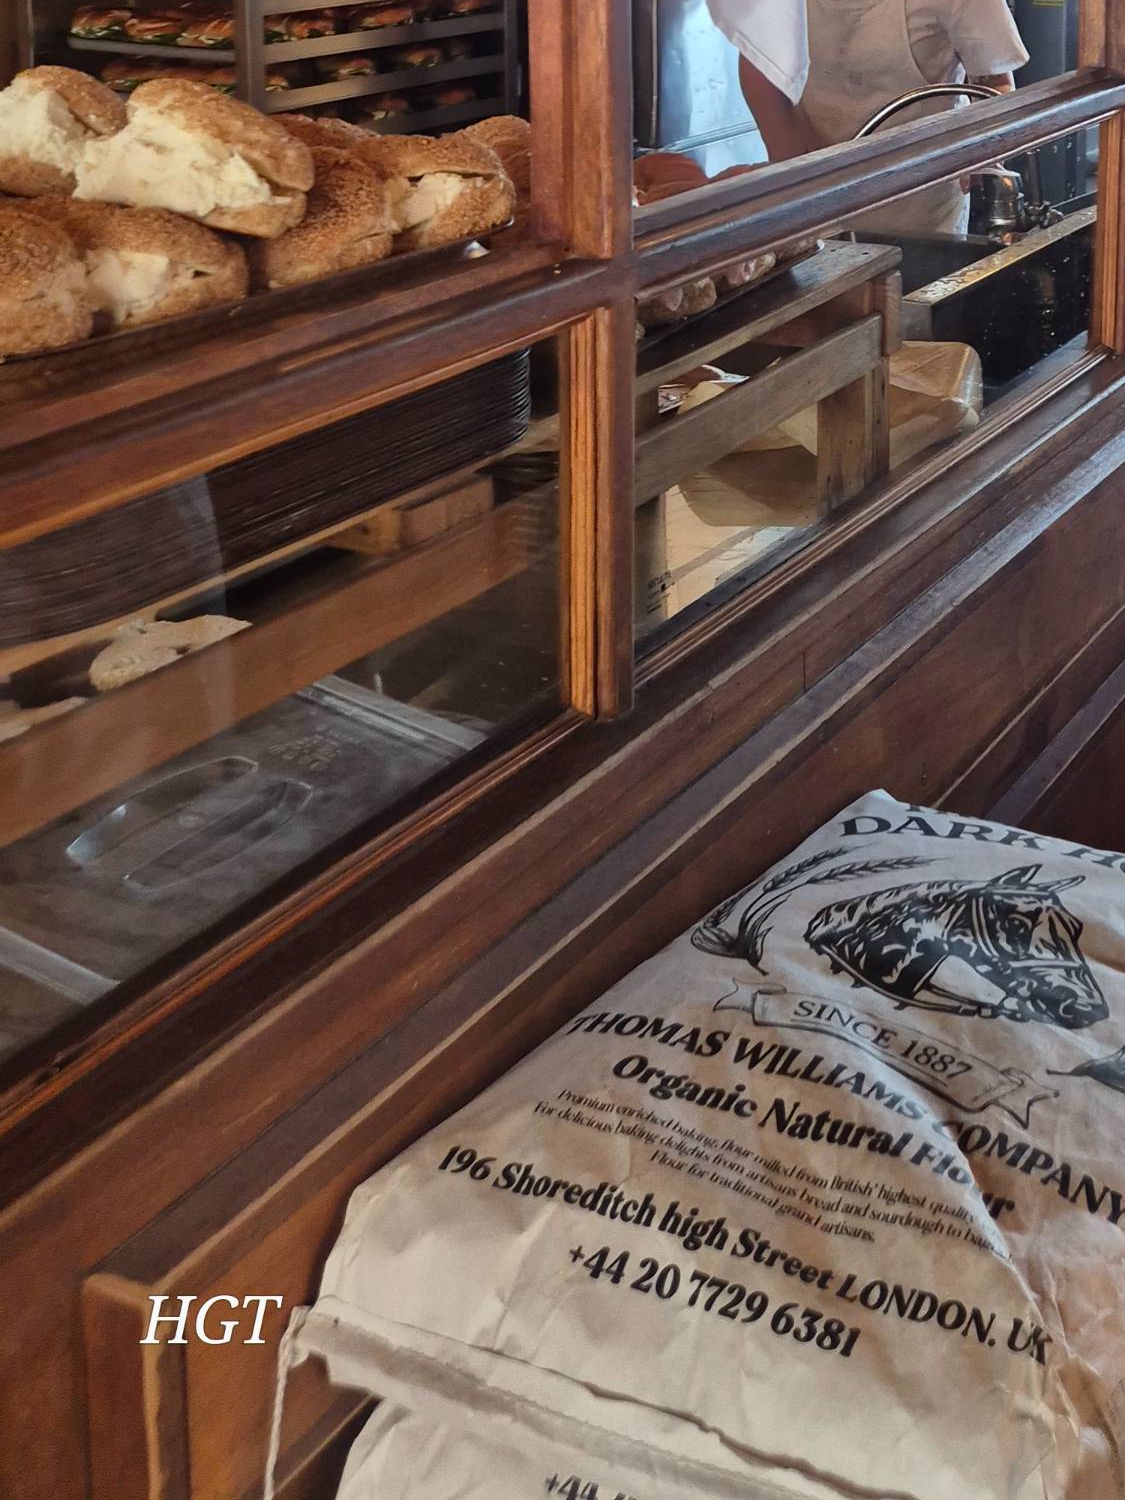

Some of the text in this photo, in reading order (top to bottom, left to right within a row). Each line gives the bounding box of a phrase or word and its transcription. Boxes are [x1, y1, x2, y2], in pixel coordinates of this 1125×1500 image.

[838, 815, 1046, 850] DARK
[566, 1011, 731, 1057] THOMAS
[732, 1036, 928, 1121] WILLIAMS
[793, 1000, 973, 1078] SINCE 1887
[557, 1088, 616, 1113] Premium
[615, 1103, 674, 1129] enriched
[720, 1138, 755, 1159] flour
[753, 1155, 798, 1178] milled
[796, 1168, 829, 1189] from
[876, 1183, 929, 1207] highest
[612, 1054, 758, 1118] Organic
[758, 1097, 914, 1157] Natural
[533, 1101, 558, 1116] For
[557, 1107, 614, 1133] delicious
[614, 1119, 659, 1145] baking
[659, 1135, 712, 1162] delights
[711, 1153, 746, 1173] from
[745, 1168, 797, 1197] artisans
[800, 1187, 842, 1213] bread
[840, 1197, 870, 1218] and
[868, 1206, 945, 1238] sourdough
[946, 1222, 963, 1238] to
[649, 1149, 689, 1172] Flour
[687, 1161, 710, 1180] for
[709, 1171, 779, 1207] traditional
[773, 1202, 823, 1228] grand
[438, 1145, 1054, 1367] 196 Shoreditch high Street LONDON. UK
[568, 1245, 862, 1358] +44 20 7729 6381
